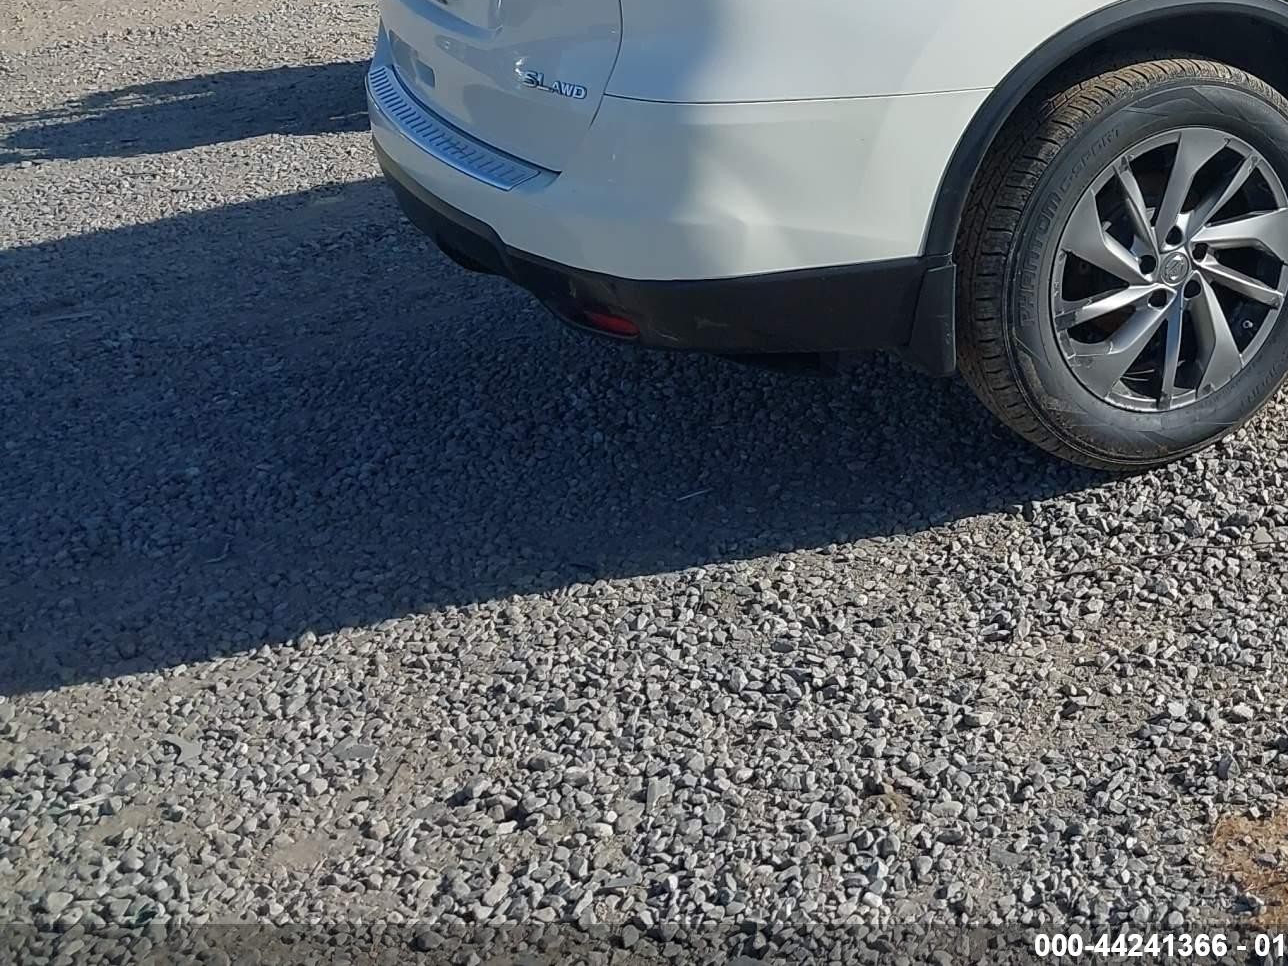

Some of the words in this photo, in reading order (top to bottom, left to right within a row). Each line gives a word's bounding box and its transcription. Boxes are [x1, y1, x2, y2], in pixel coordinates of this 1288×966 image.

[522, 69, 555, 93] SL
[551, 80, 588, 100] AWD
[1019, 190, 1064, 328] PHANTOM
